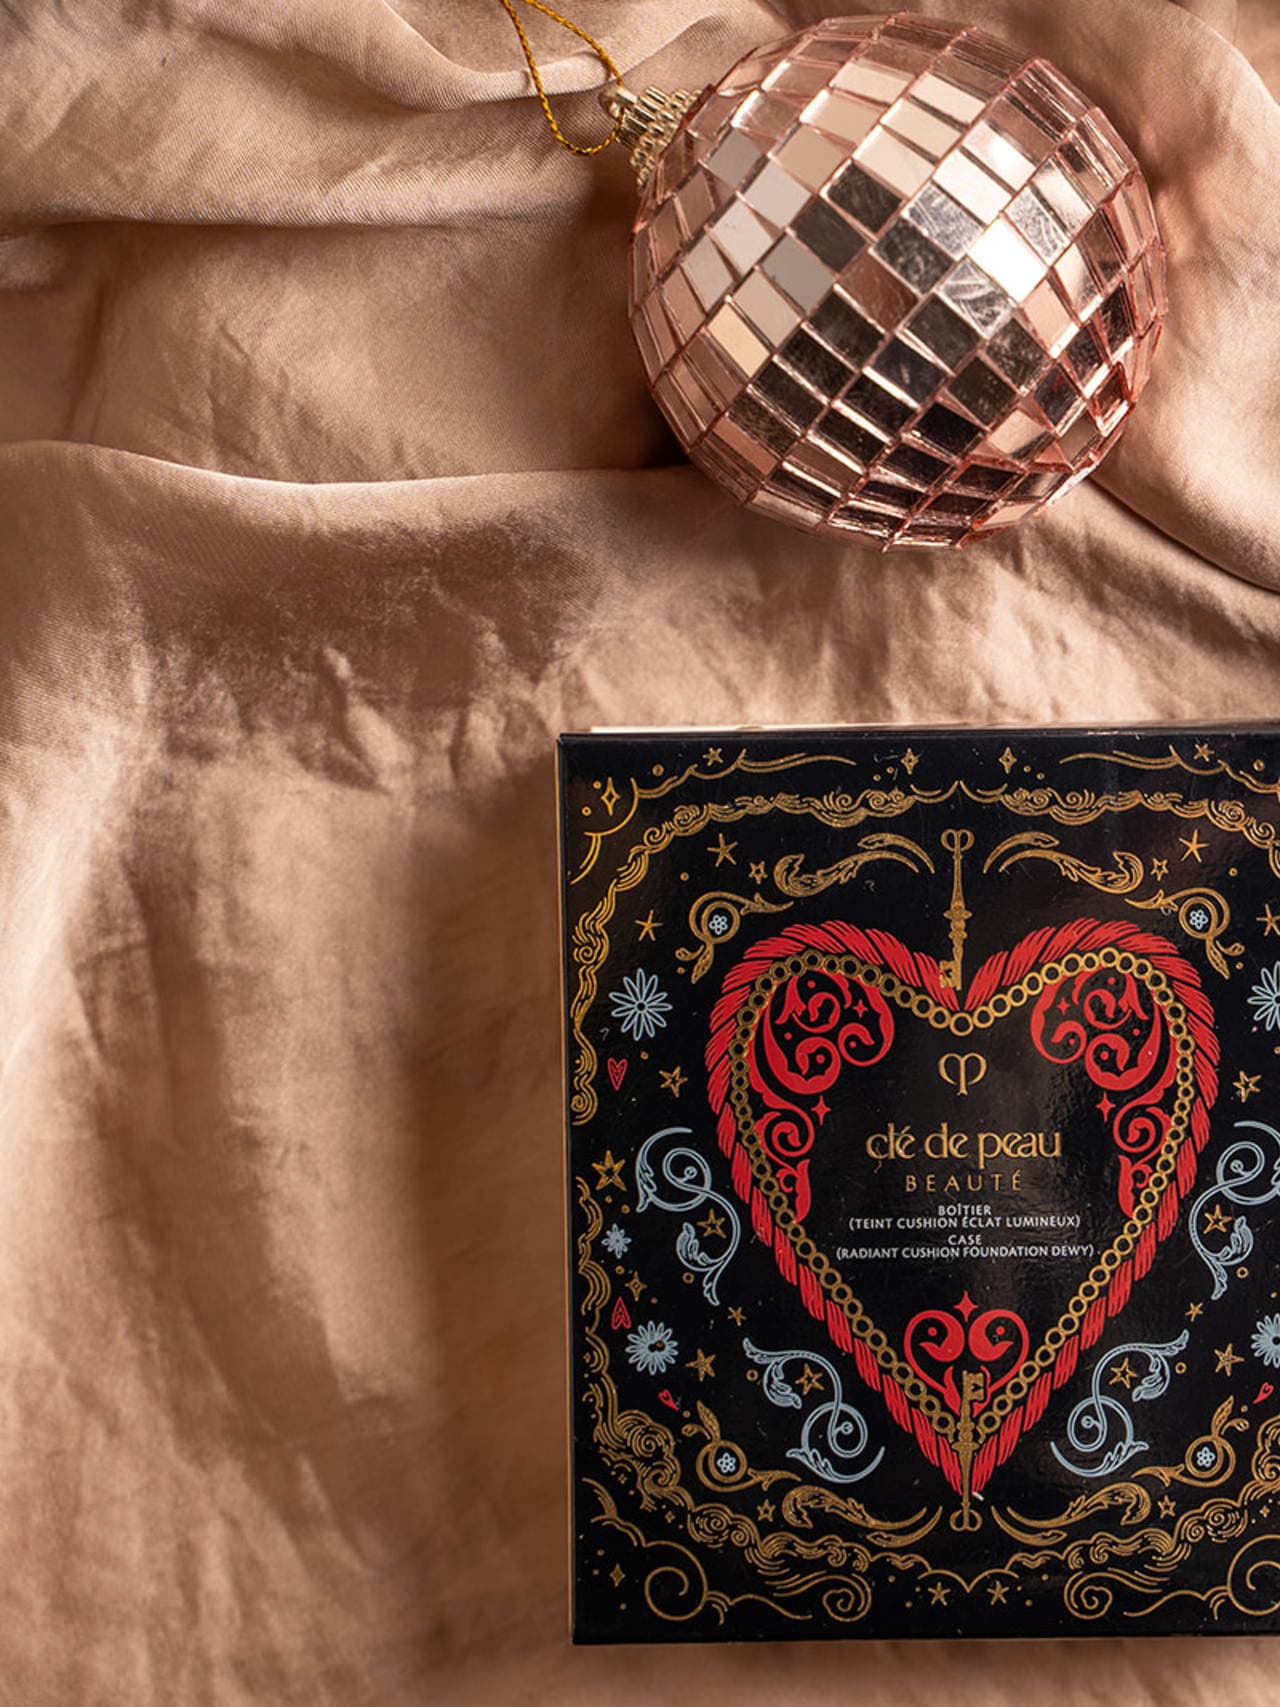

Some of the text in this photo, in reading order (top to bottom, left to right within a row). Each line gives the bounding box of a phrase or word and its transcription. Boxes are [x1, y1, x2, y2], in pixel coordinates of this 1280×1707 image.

[866, 1122, 1062, 1170] clé de peau
[905, 1169, 1022, 1193] BEAUTÉ
[938, 1202, 992, 1217] BOÎTIER
[848, 1214, 1081, 1231] (TEINT CUSHION ÉCLAT LUMINEUX)
[948, 1234, 982, 1246] CASE
[836, 1244, 1095, 1261] (RADIANT CUSHION FOUNDATION DEWY)
